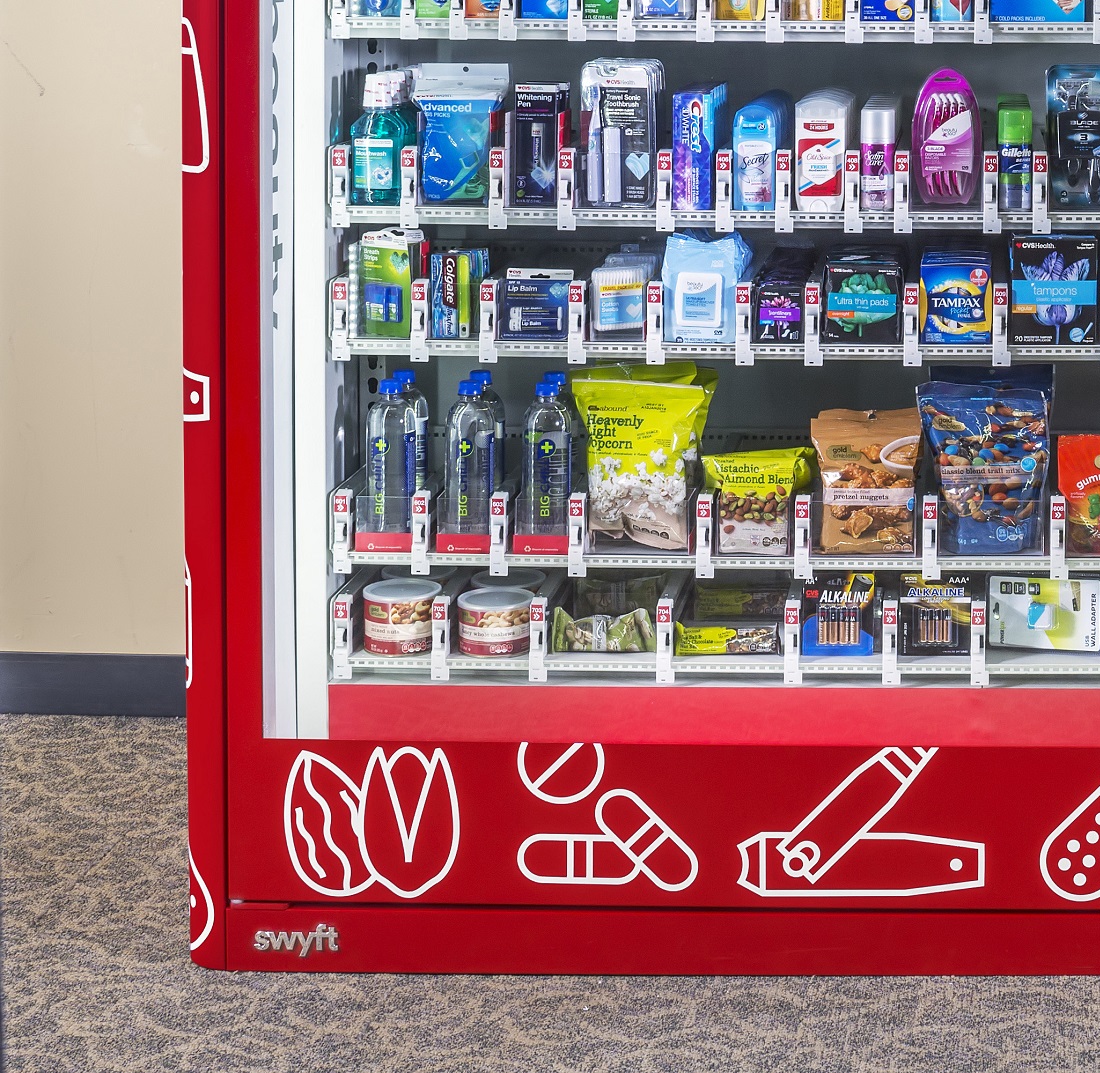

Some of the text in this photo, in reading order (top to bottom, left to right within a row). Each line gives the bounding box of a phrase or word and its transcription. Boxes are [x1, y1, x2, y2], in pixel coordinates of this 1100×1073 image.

[691, 100, 701, 153] Crest
[743, 153, 769, 167] Secret
[446, 258, 455, 304] Colgate
[1033, 285, 1077, 296] tampons
[870, 298, 888, 307] pads
[932, 298, 980, 308] TAMPAX
[587, 414, 644, 428] Heavenly
[724, 474, 764, 484] Almond
[375, 493, 384, 514] BIG
[833, 493, 858, 501] pretzel
[459, 495, 468, 516] BIG
[540, 496, 550, 517] BIG
[820, 590, 870, 603] ALKALINE
[908, 587, 964, 597] ALKALINE
[254, 923, 339, 957] swyft
